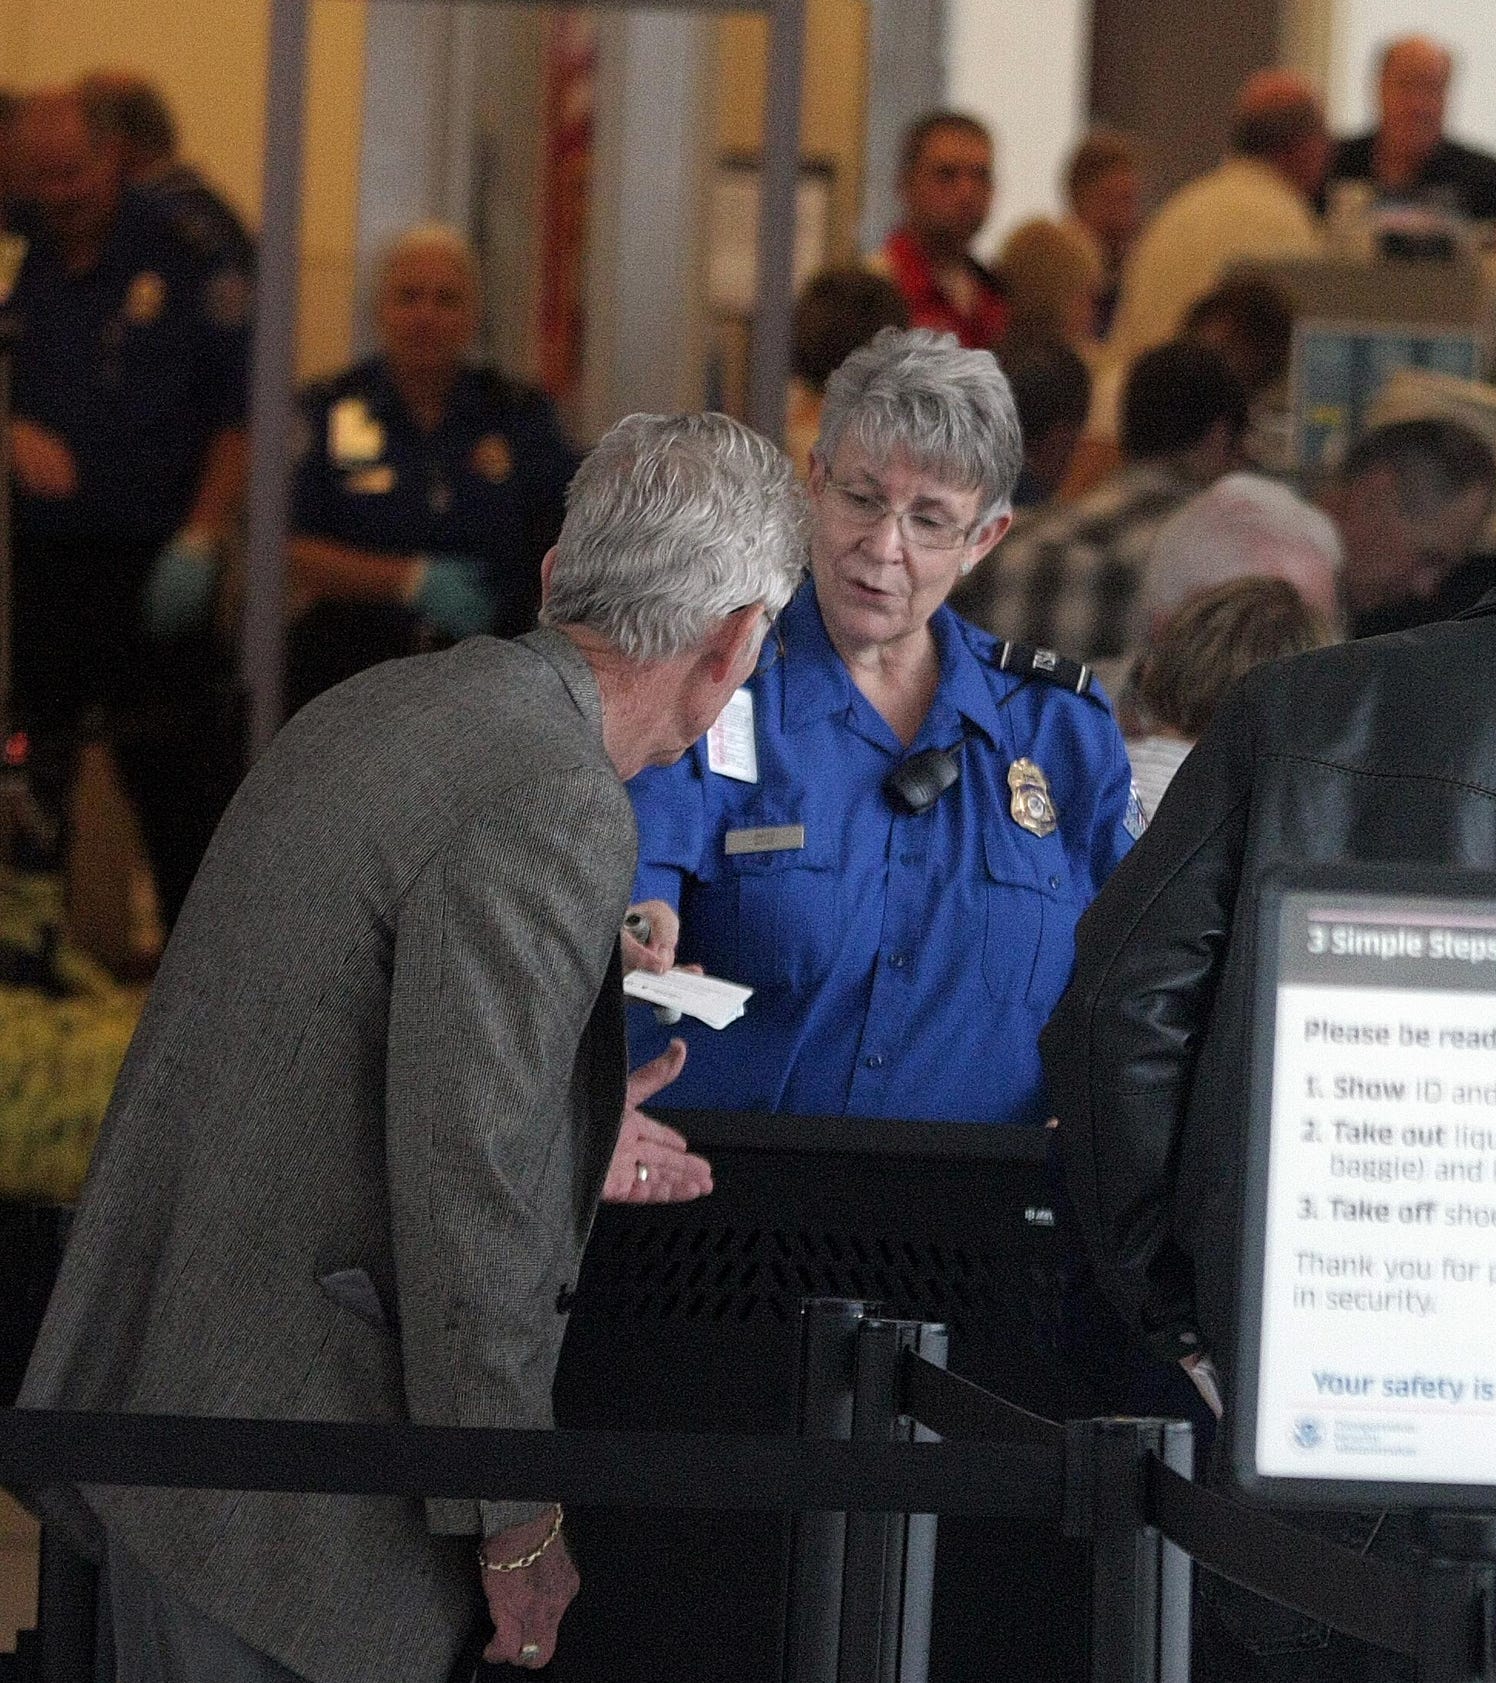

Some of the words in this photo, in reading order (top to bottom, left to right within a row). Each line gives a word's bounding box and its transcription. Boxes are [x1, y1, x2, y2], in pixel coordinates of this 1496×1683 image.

[1307, 924, 1327, 955] 3
[1331, 926, 1422, 961] Simple
[1304, 1014, 1390, 1046] Please
[1399, 1018, 1430, 1048] be
[1305, 1074, 1325, 1100] 1.
[1333, 1075, 1406, 1102] Show
[1416, 1077, 1443, 1104] ID
[1302, 1118, 1322, 1144] 2.
[1333, 1119, 1394, 1147] Take
[1400, 1126, 1446, 1150] out
[1330, 1153, 1425, 1184] baggie)
[1434, 1158, 1484, 1183] and
[1298, 1197, 1318, 1222] 3.
[1329, 1197, 1391, 1225] Take
[1398, 1202, 1436, 1226] off
[1296, 1250, 1374, 1278] Thank
[1383, 1257, 1432, 1283] you
[1441, 1257, 1480, 1282] for
[1293, 1283, 1315, 1310] in
[1312, 1371, 1375, 1398] Your
[1382, 1376, 1464, 1406] safety
[1474, 1376, 1495, 1402] is
